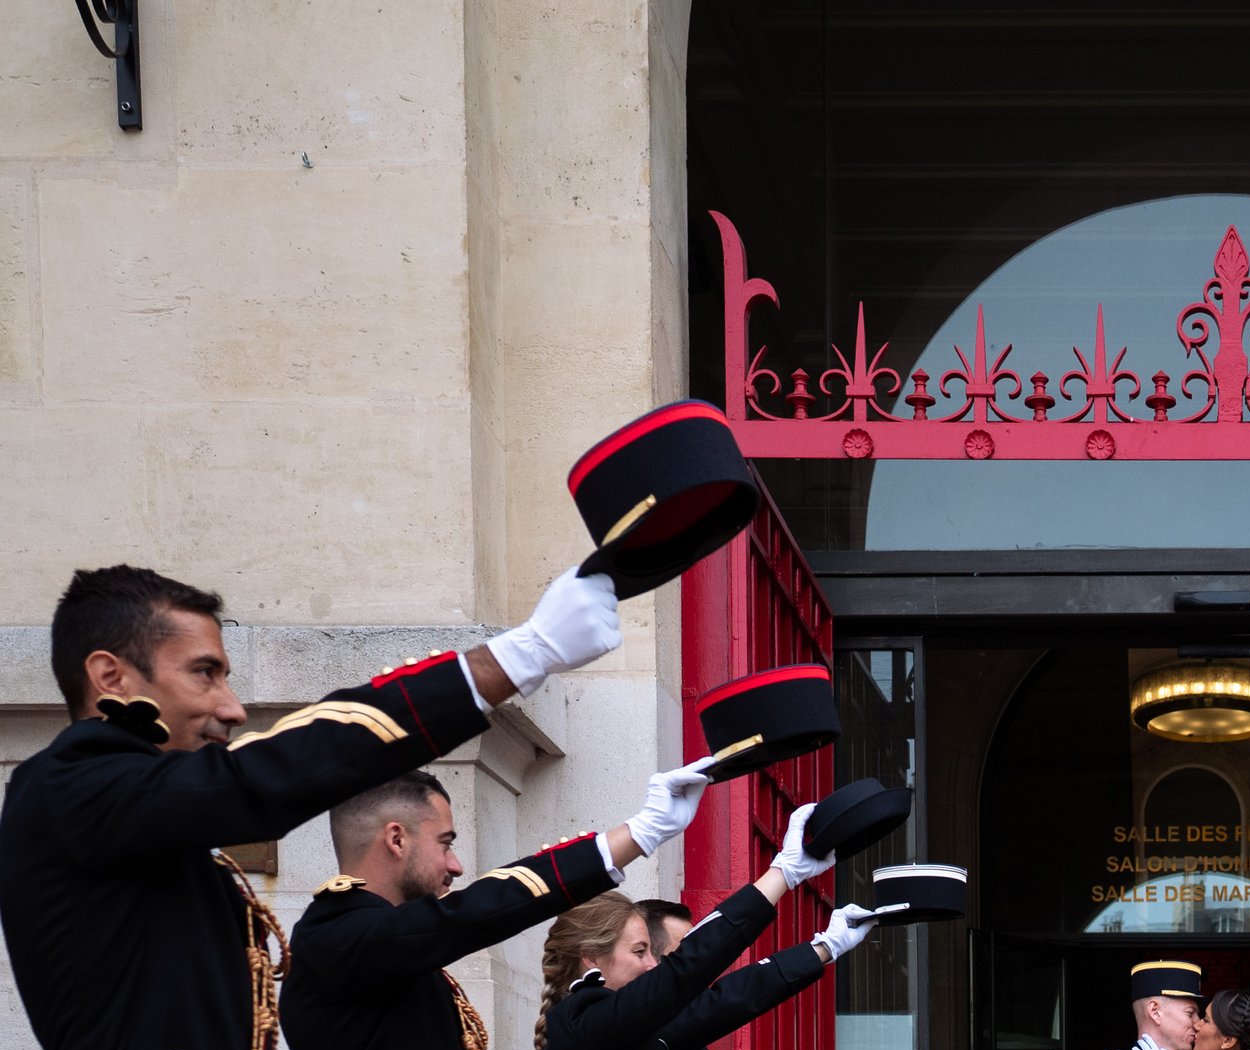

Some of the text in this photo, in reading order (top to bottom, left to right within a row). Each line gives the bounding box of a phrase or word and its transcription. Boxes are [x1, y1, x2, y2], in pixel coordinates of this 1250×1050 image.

[1113, 825, 1180, 843] SALLE
[1186, 825, 1228, 843] DES
[1106, 856, 1177, 873] SALON
[1091, 885, 1157, 903] SALLE
[1164, 885, 1205, 902] DES
